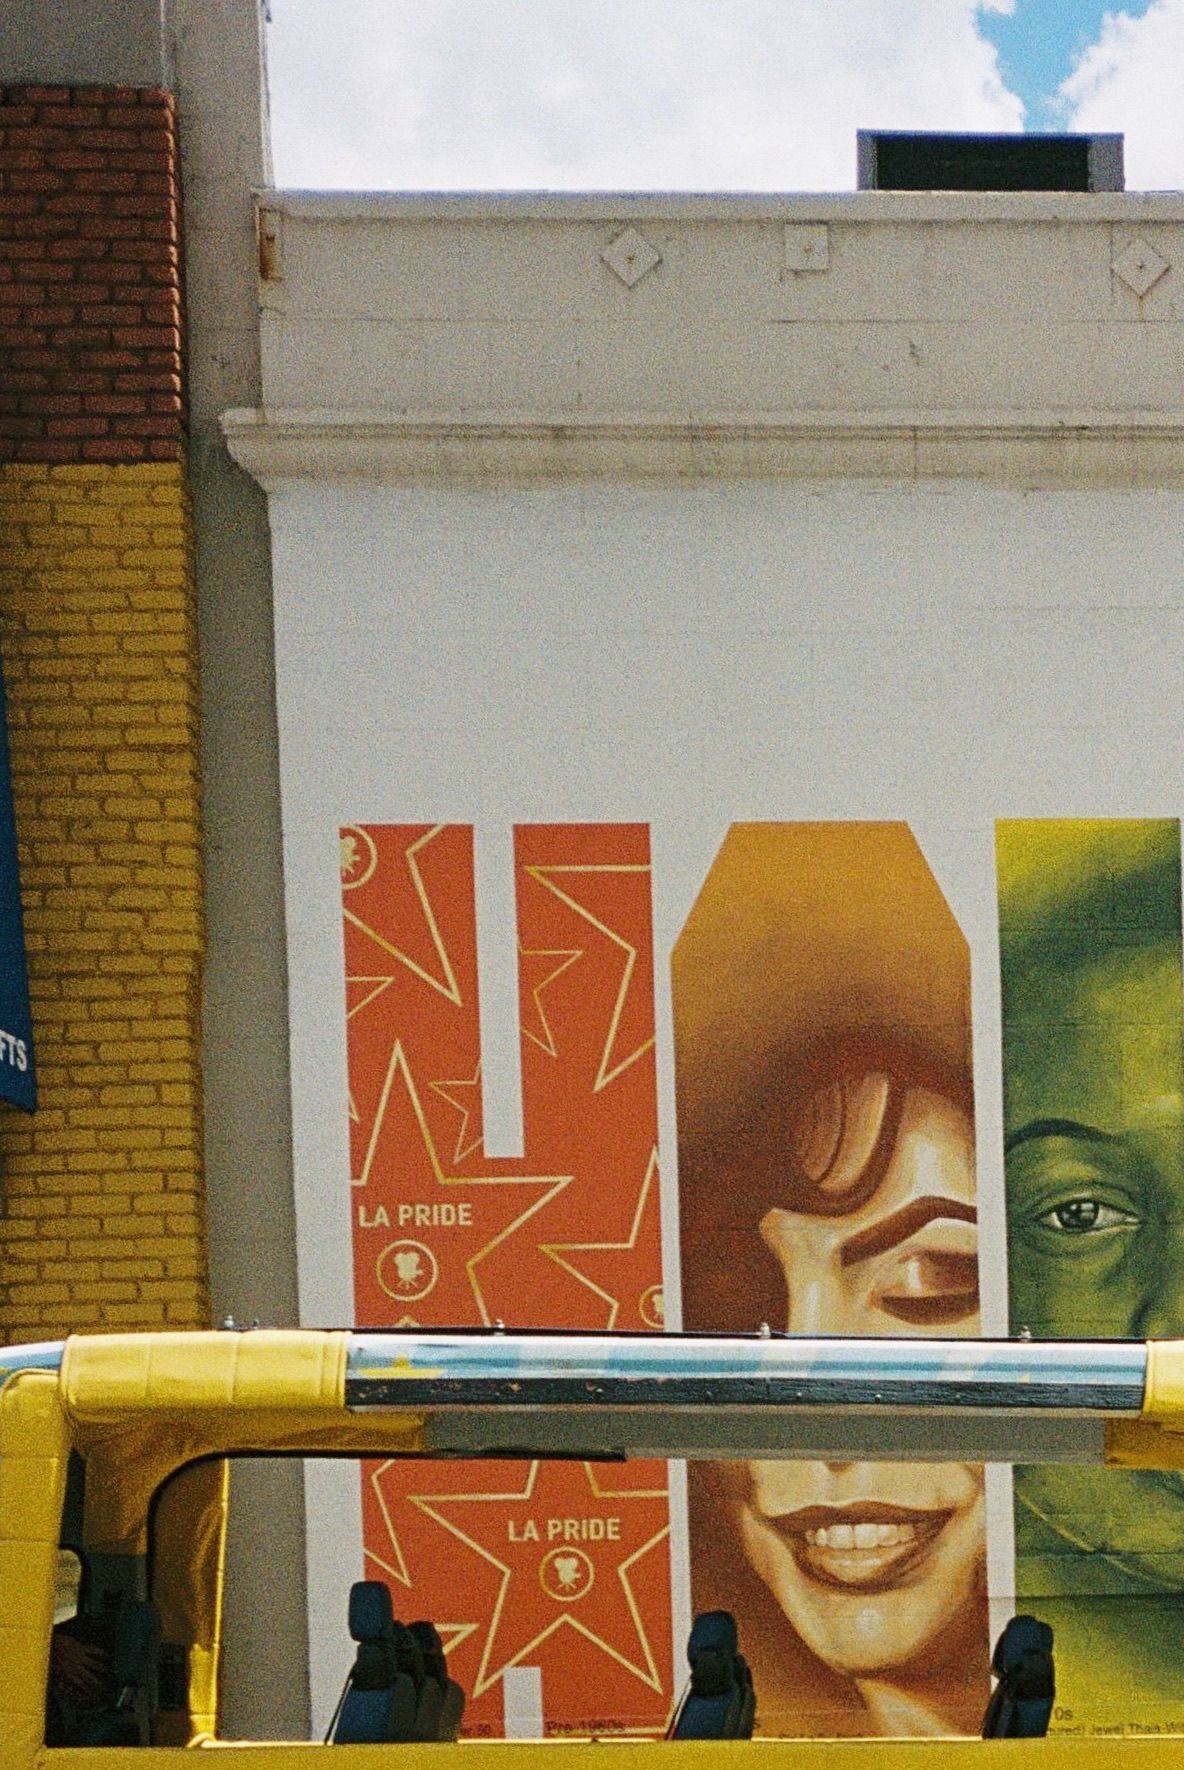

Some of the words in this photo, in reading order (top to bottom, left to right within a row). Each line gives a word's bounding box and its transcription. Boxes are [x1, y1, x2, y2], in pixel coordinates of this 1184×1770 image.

[358, 1204, 391, 1228] LA
[398, 1203, 473, 1227] PRIDE
[507, 1519, 540, 1541] LA
[547, 1518, 621, 1541] PRIDE
